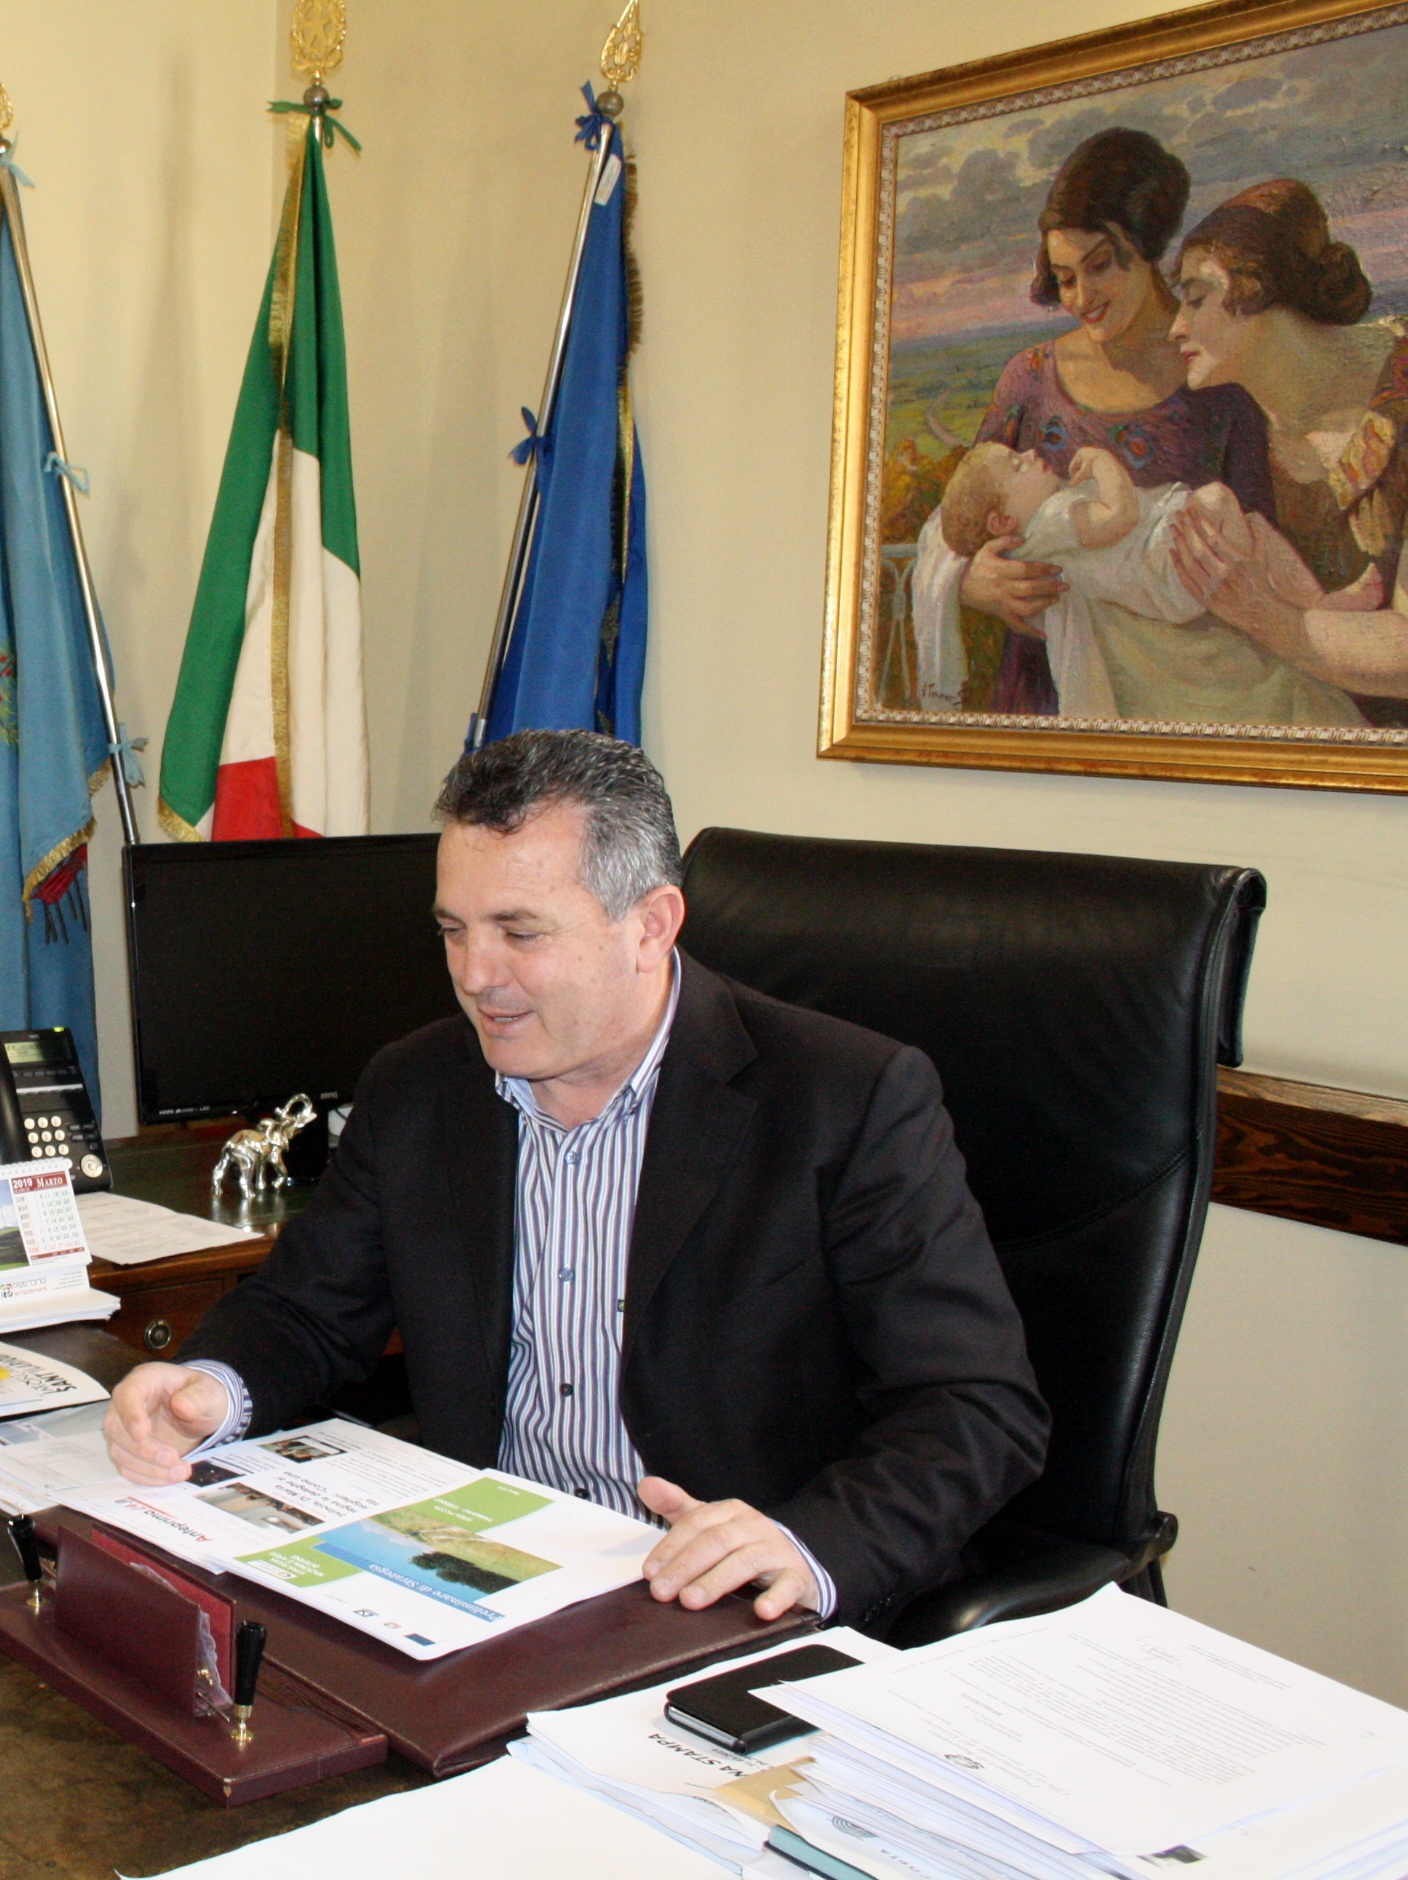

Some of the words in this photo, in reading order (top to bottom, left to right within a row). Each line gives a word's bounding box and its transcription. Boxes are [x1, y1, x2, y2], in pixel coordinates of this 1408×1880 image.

[12, 1178, 33, 1189] 2019
[36, 1177, 63, 1188] MARZO
[368, 1563, 419, 1589] Strategia
[417, 1585, 432, 1594] di
[431, 1590, 503, 1621] Preliminare
[647, 1733, 722, 1766] STAMPA
